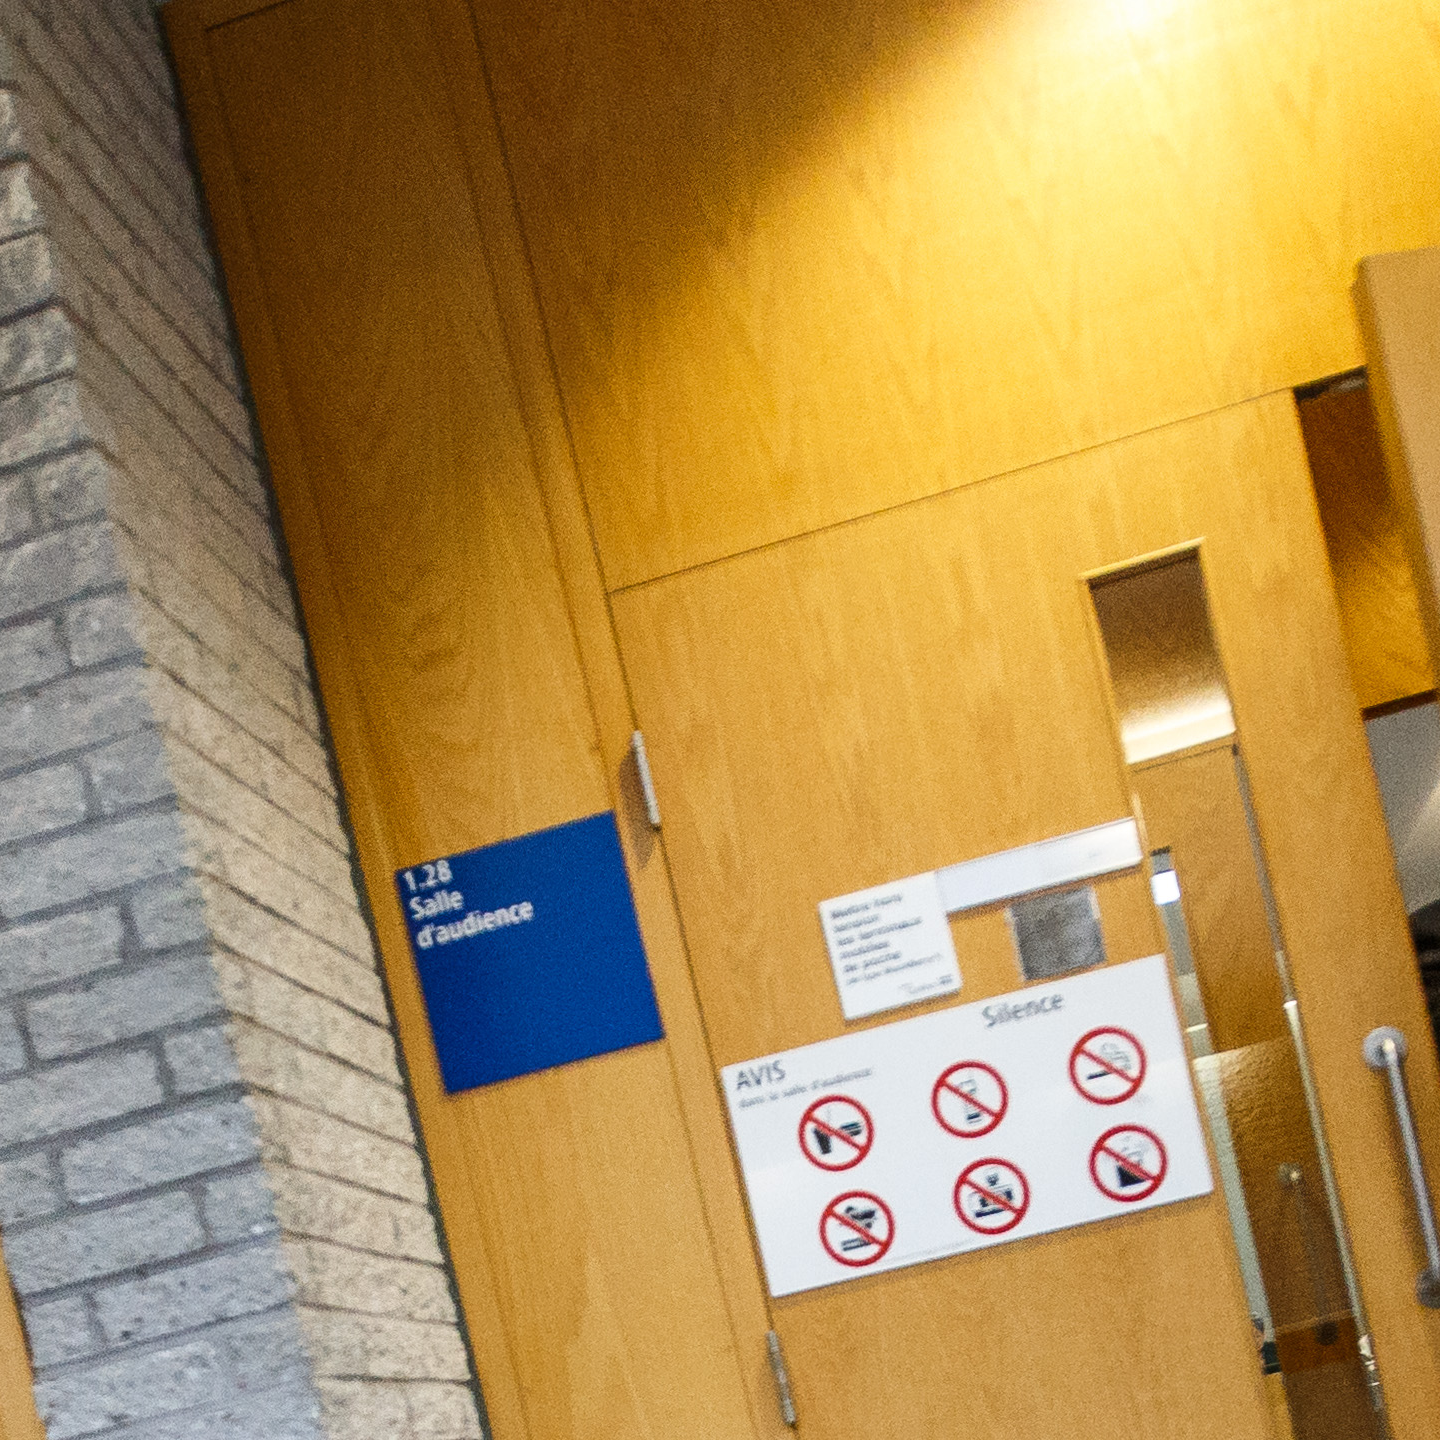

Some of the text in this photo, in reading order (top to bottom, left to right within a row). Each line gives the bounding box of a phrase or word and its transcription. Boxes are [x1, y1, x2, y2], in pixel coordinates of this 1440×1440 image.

[404, 859, 452, 892] 1.28
[409, 889, 464, 921] Salle
[416, 901, 534, 949] d'audience
[982, 994, 1063, 1028] Silence
[733, 1059, 786, 1090] AVIS
